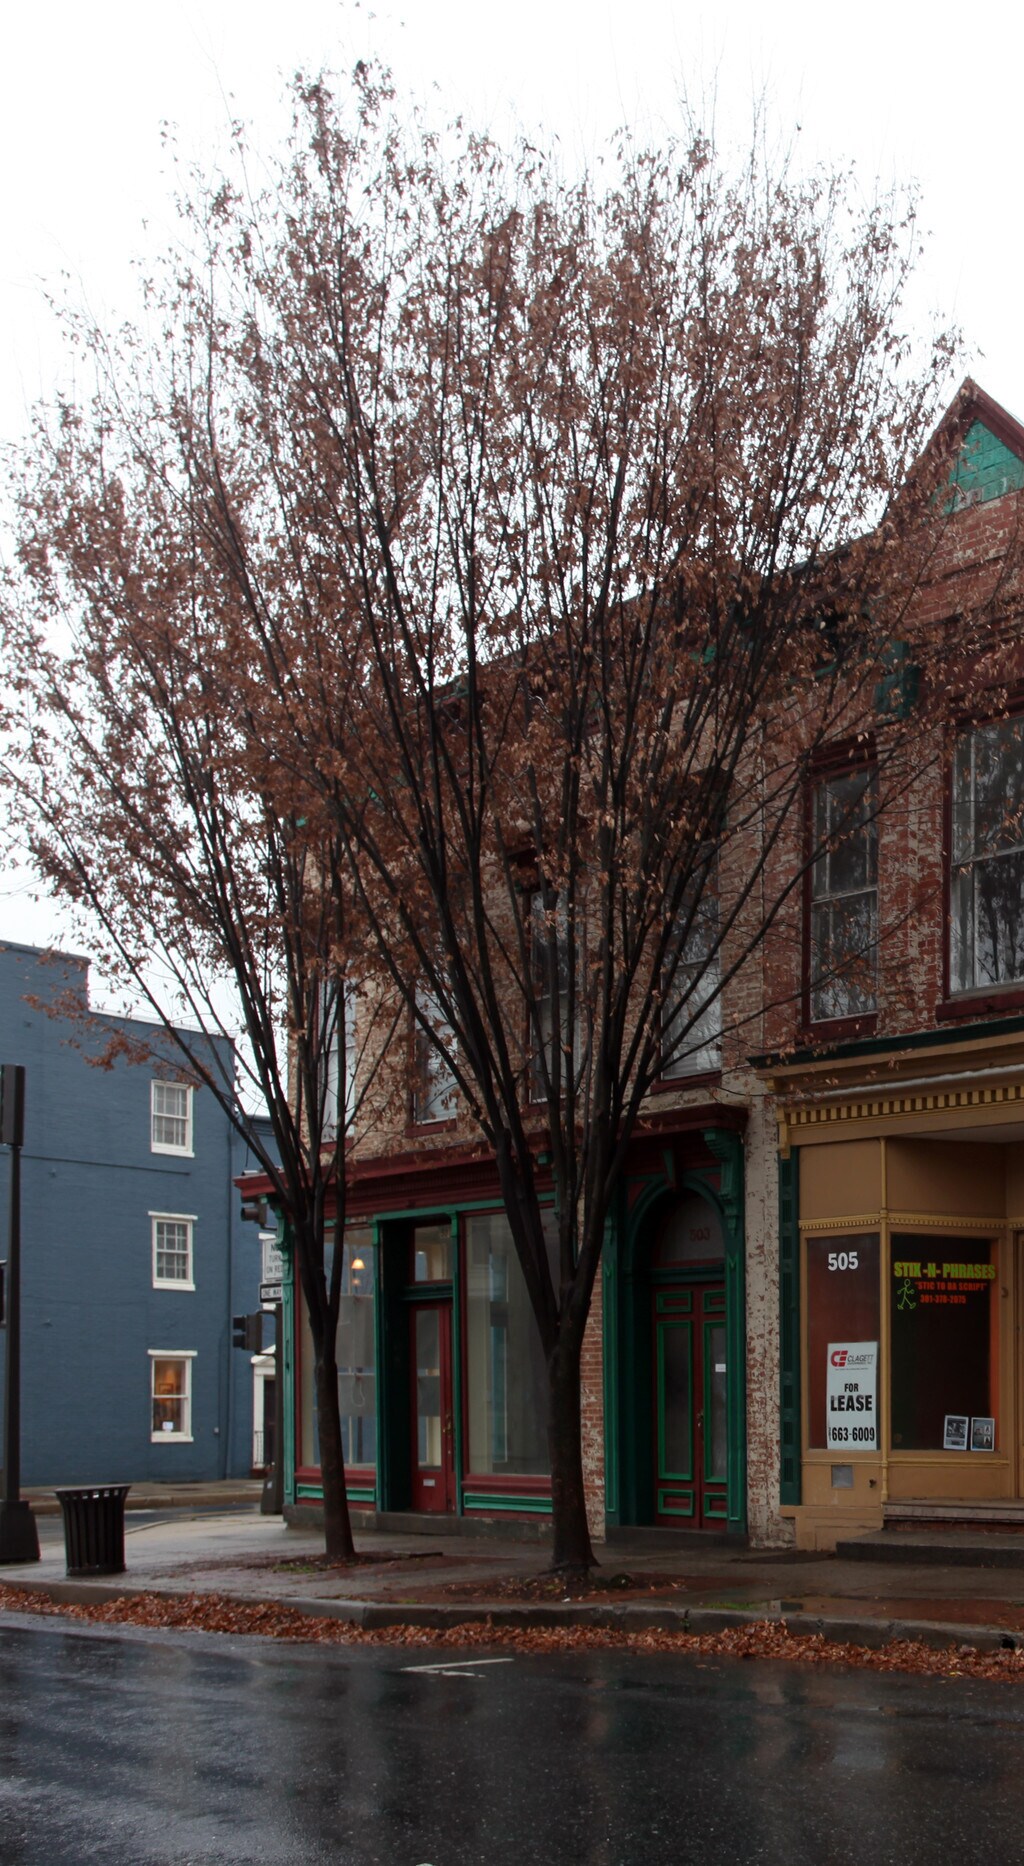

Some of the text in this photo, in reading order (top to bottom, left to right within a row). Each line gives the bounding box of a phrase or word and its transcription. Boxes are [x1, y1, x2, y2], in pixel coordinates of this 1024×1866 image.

[828, 1252, 858, 1270] 505
[894, 1262, 921, 1278] STIX
[943, 1263, 995, 1279] PHRASES
[844, 1383, 859, 1392] FOR
[830, 1395, 872, 1411] LEASE
[832, 1427, 875, 1441] 663-6009
